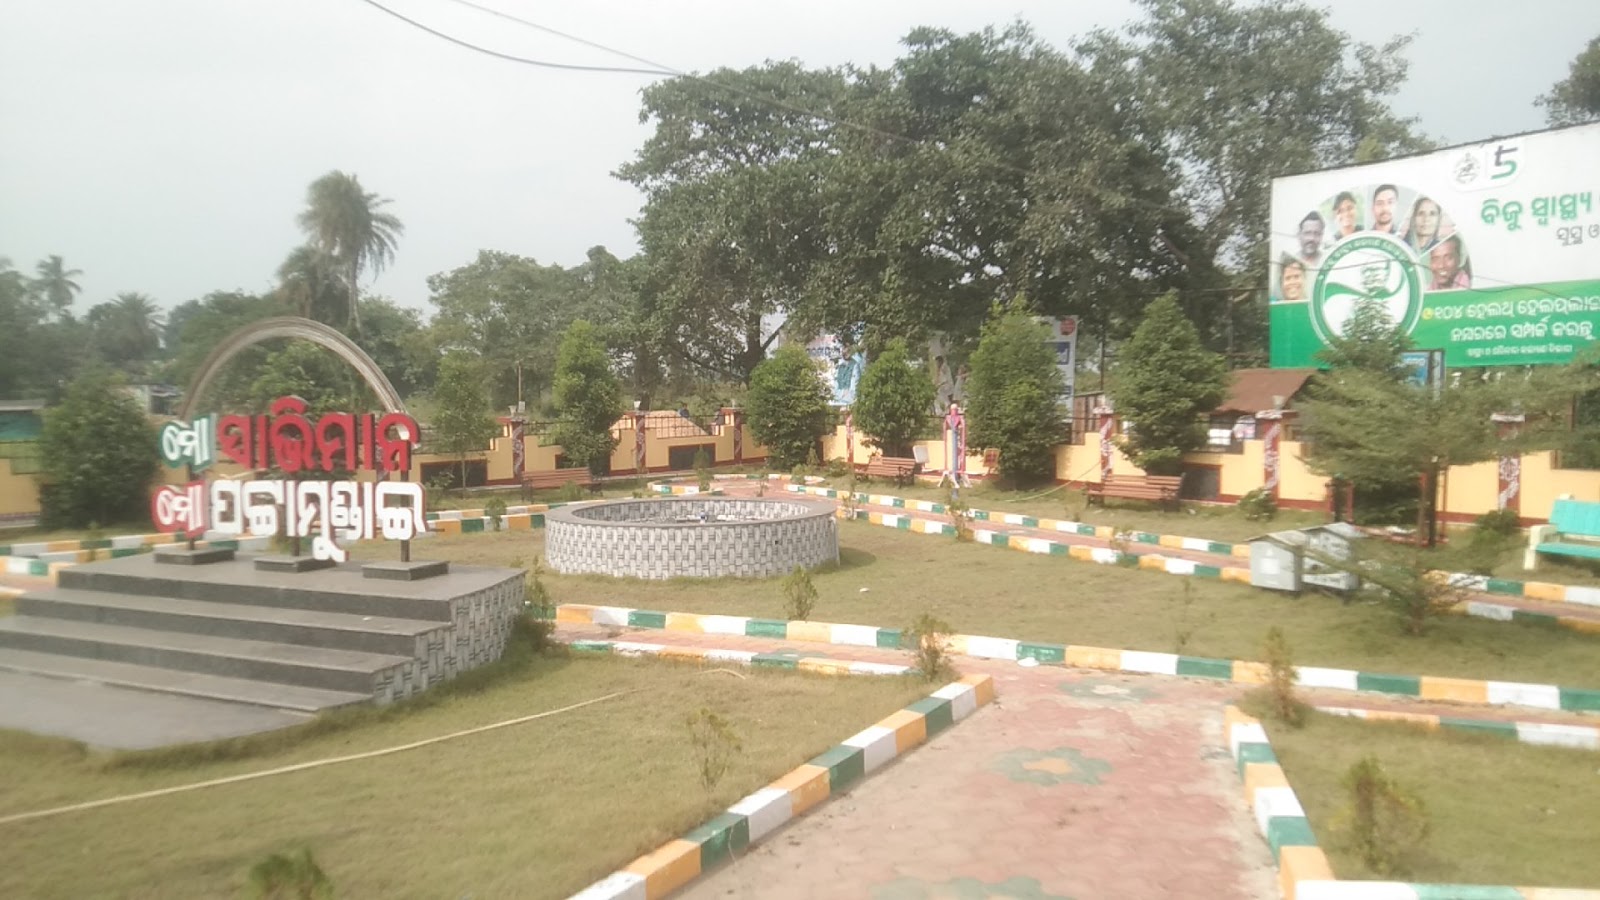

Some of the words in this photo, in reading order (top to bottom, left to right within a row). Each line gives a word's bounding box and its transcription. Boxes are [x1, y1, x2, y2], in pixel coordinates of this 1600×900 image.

[1480, 198, 1524, 232] ବିଜୁ
[161, 416, 213, 469] ମୋ
[153, 482, 206, 535] ମୋ
